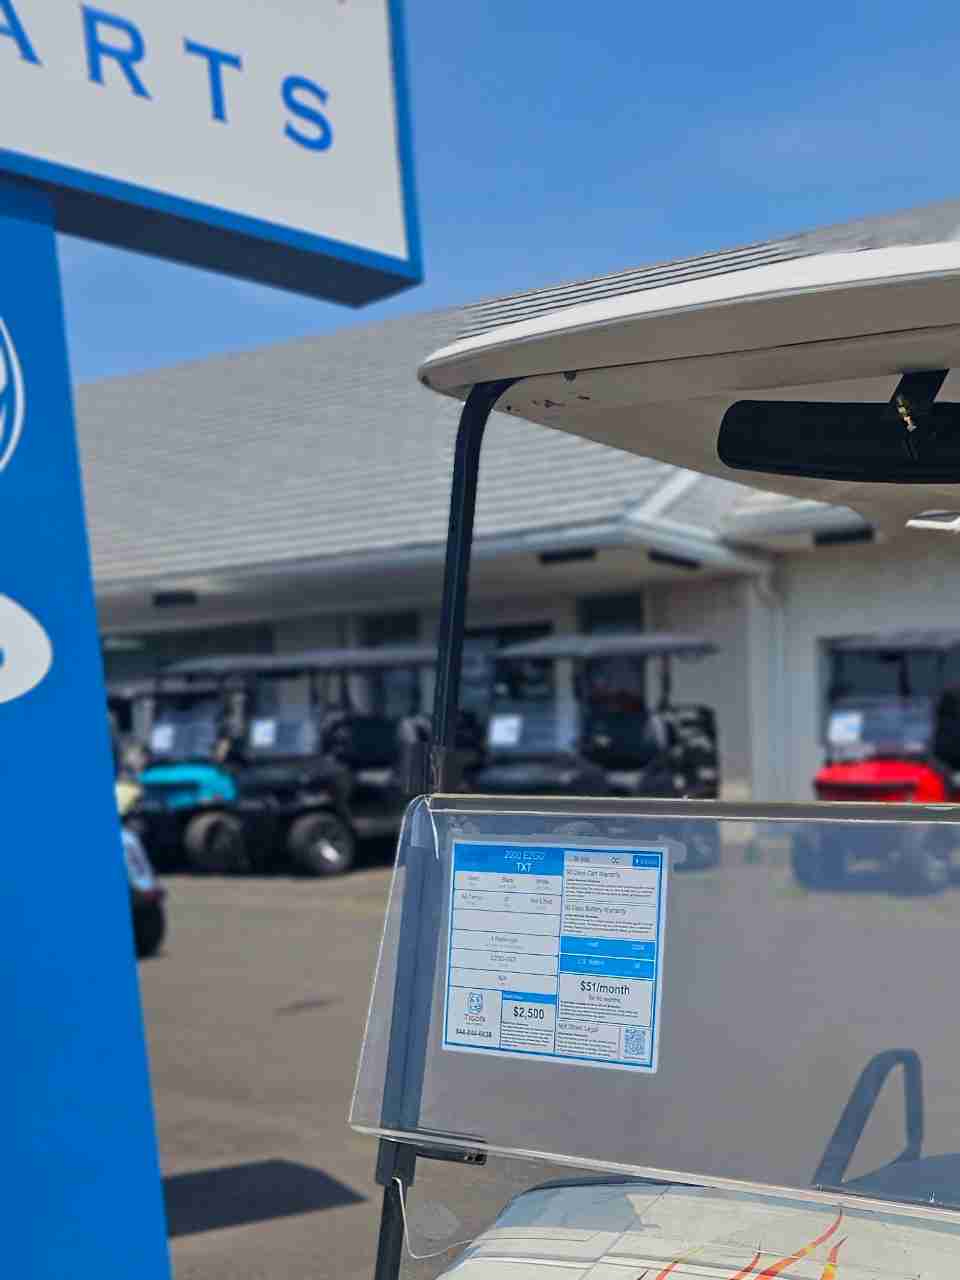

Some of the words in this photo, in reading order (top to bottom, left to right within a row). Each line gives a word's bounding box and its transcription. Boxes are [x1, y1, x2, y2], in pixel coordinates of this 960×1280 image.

[516, 862, 532, 872] TXT
[580, 980, 630, 995] $51/month
[513, 1007, 545, 1020] $2,500
